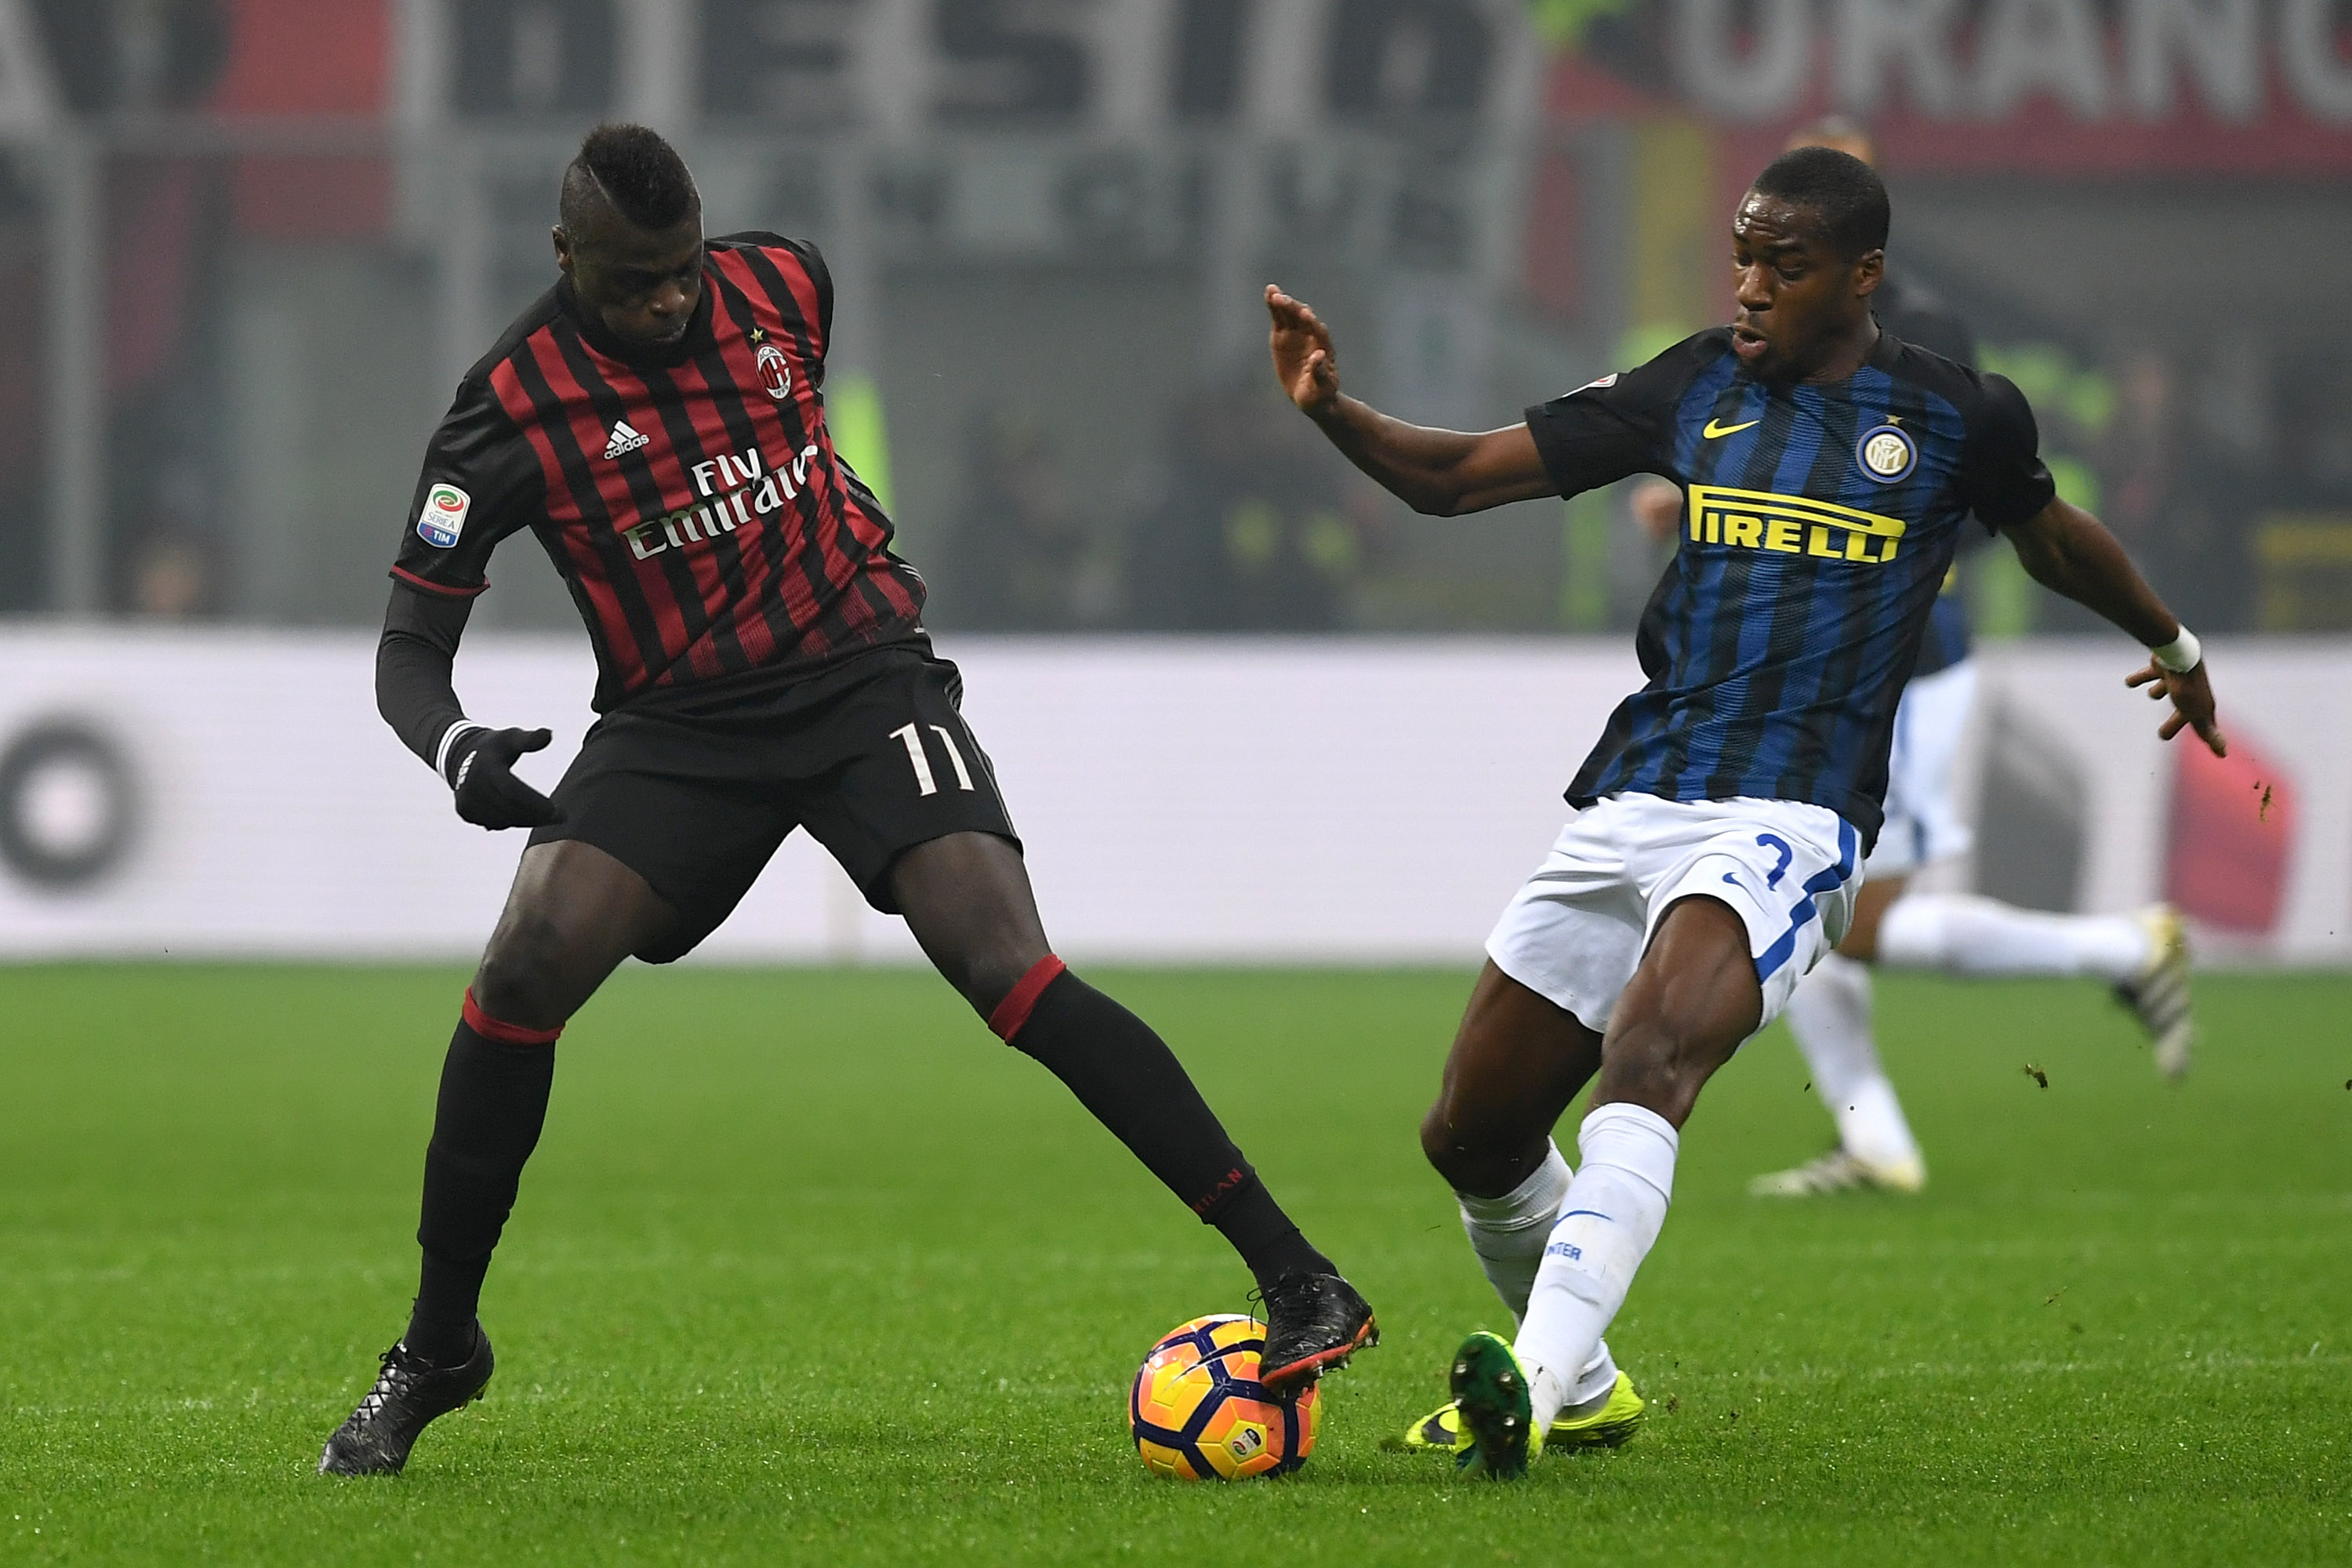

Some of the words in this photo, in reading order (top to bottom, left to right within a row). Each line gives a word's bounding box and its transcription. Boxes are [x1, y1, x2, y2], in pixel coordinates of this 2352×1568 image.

[759, 348, 778, 364] ACM
[774, 384, 789, 397] 1899
[604, 434, 650, 460] adidas
[691, 448, 762, 496] Fly
[427, 512, 448, 527] SERIE
[1688, 483, 1907, 564] PIRELLI
[434, 530, 451, 545] TIM
[888, 720, 976, 797] 11
